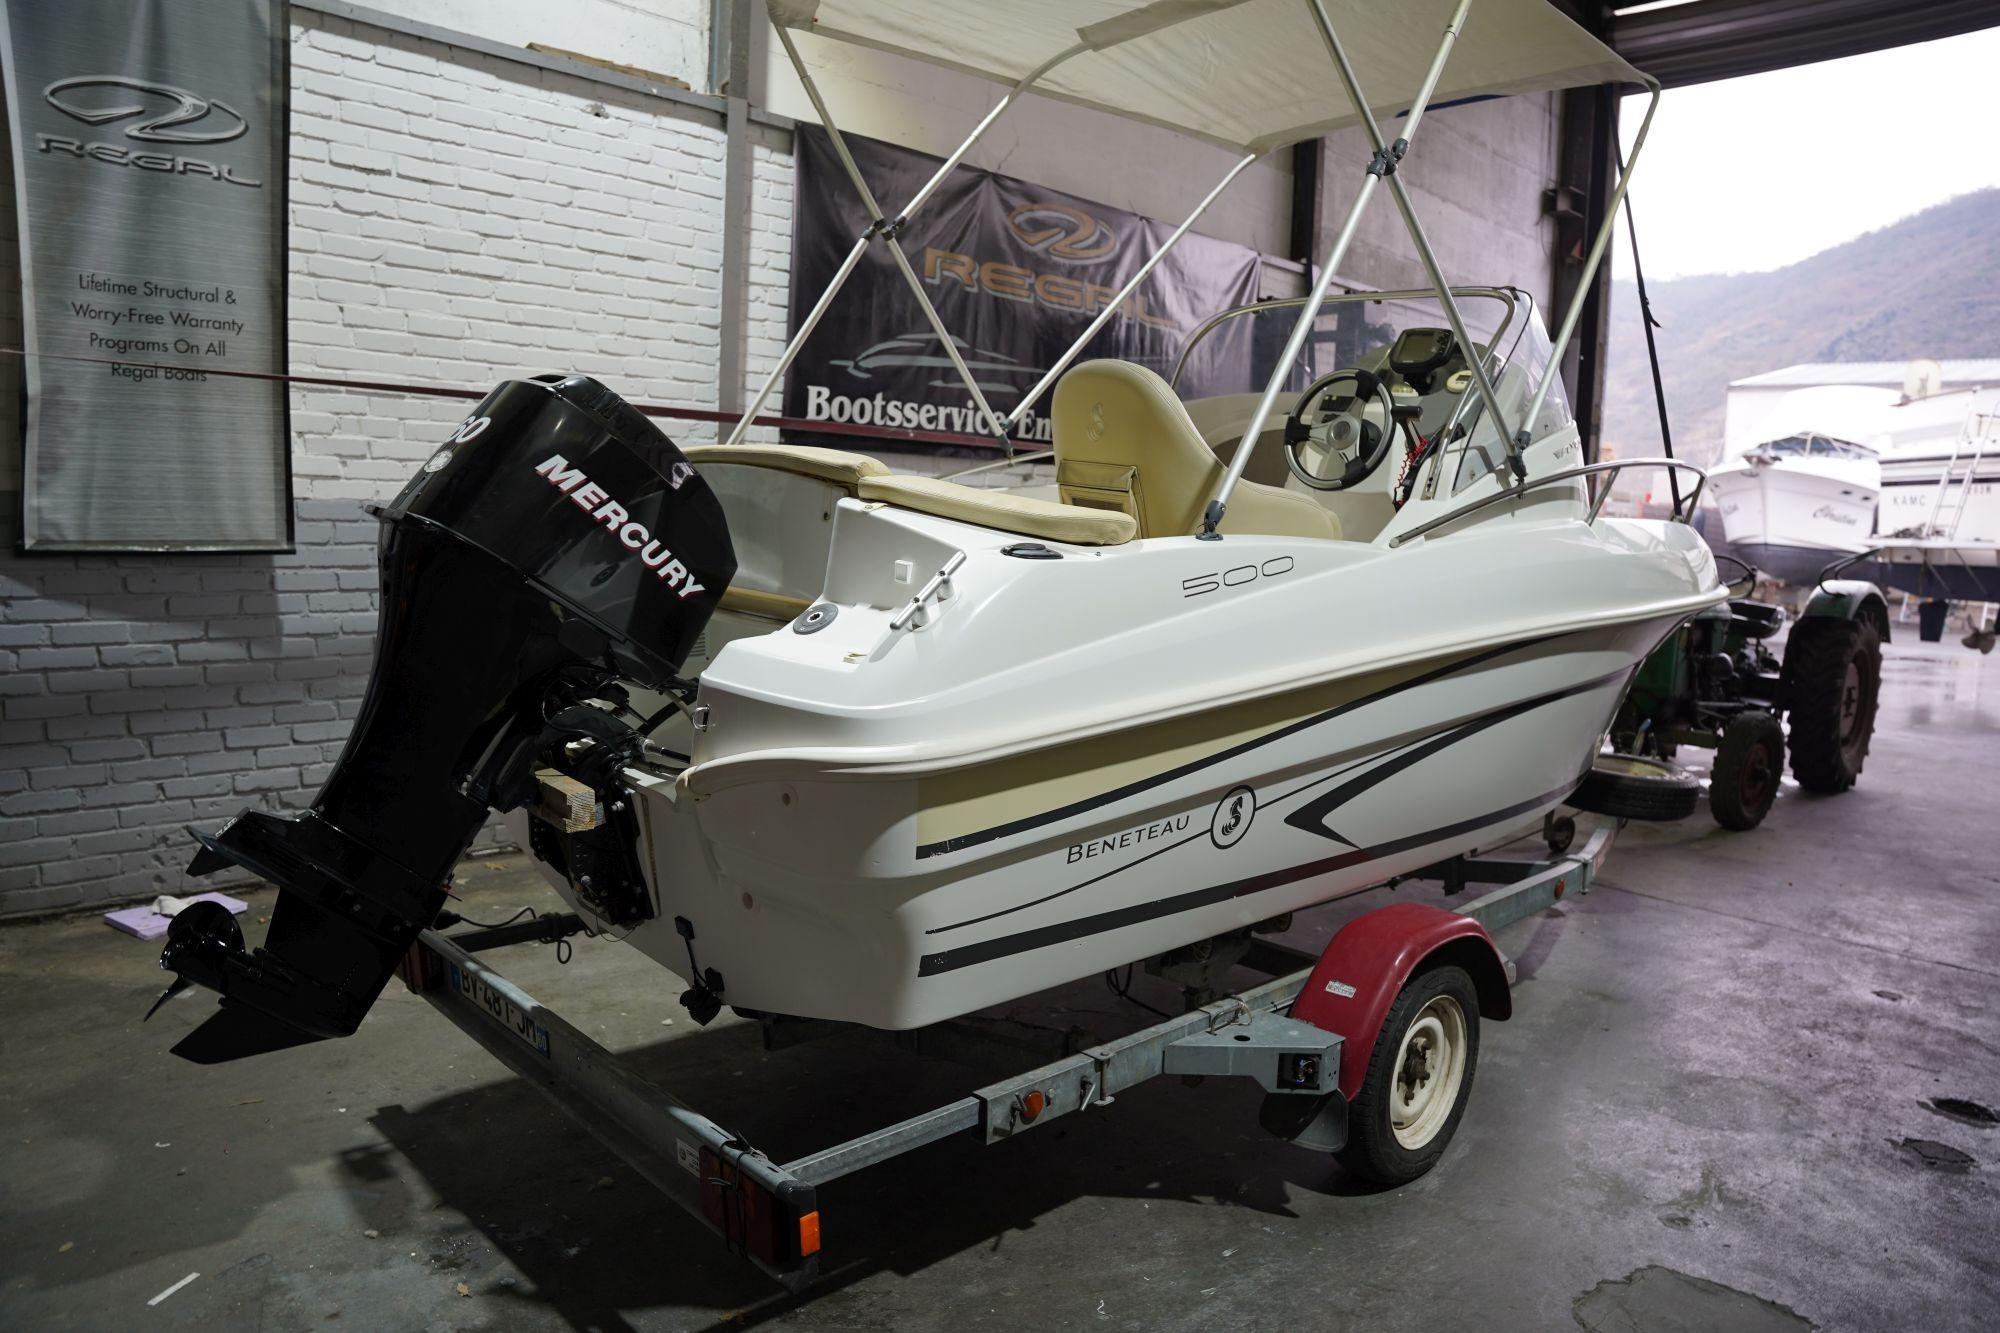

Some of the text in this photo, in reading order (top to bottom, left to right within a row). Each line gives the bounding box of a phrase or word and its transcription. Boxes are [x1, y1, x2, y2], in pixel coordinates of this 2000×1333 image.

[36, 132, 262, 188] REGAL
[78, 273, 237, 304] Lifetime Structural &
[924, 246, 1180, 331] REGAL
[72, 302, 244, 335] Worry-Free Warranty
[90, 332, 226, 356] Programs On All
[111, 361, 207, 382] Regal Boats
[534, 454, 706, 599] MERCURY
[1182, 555, 1294, 598] 500
[1066, 815, 1190, 865] BENETEAU
